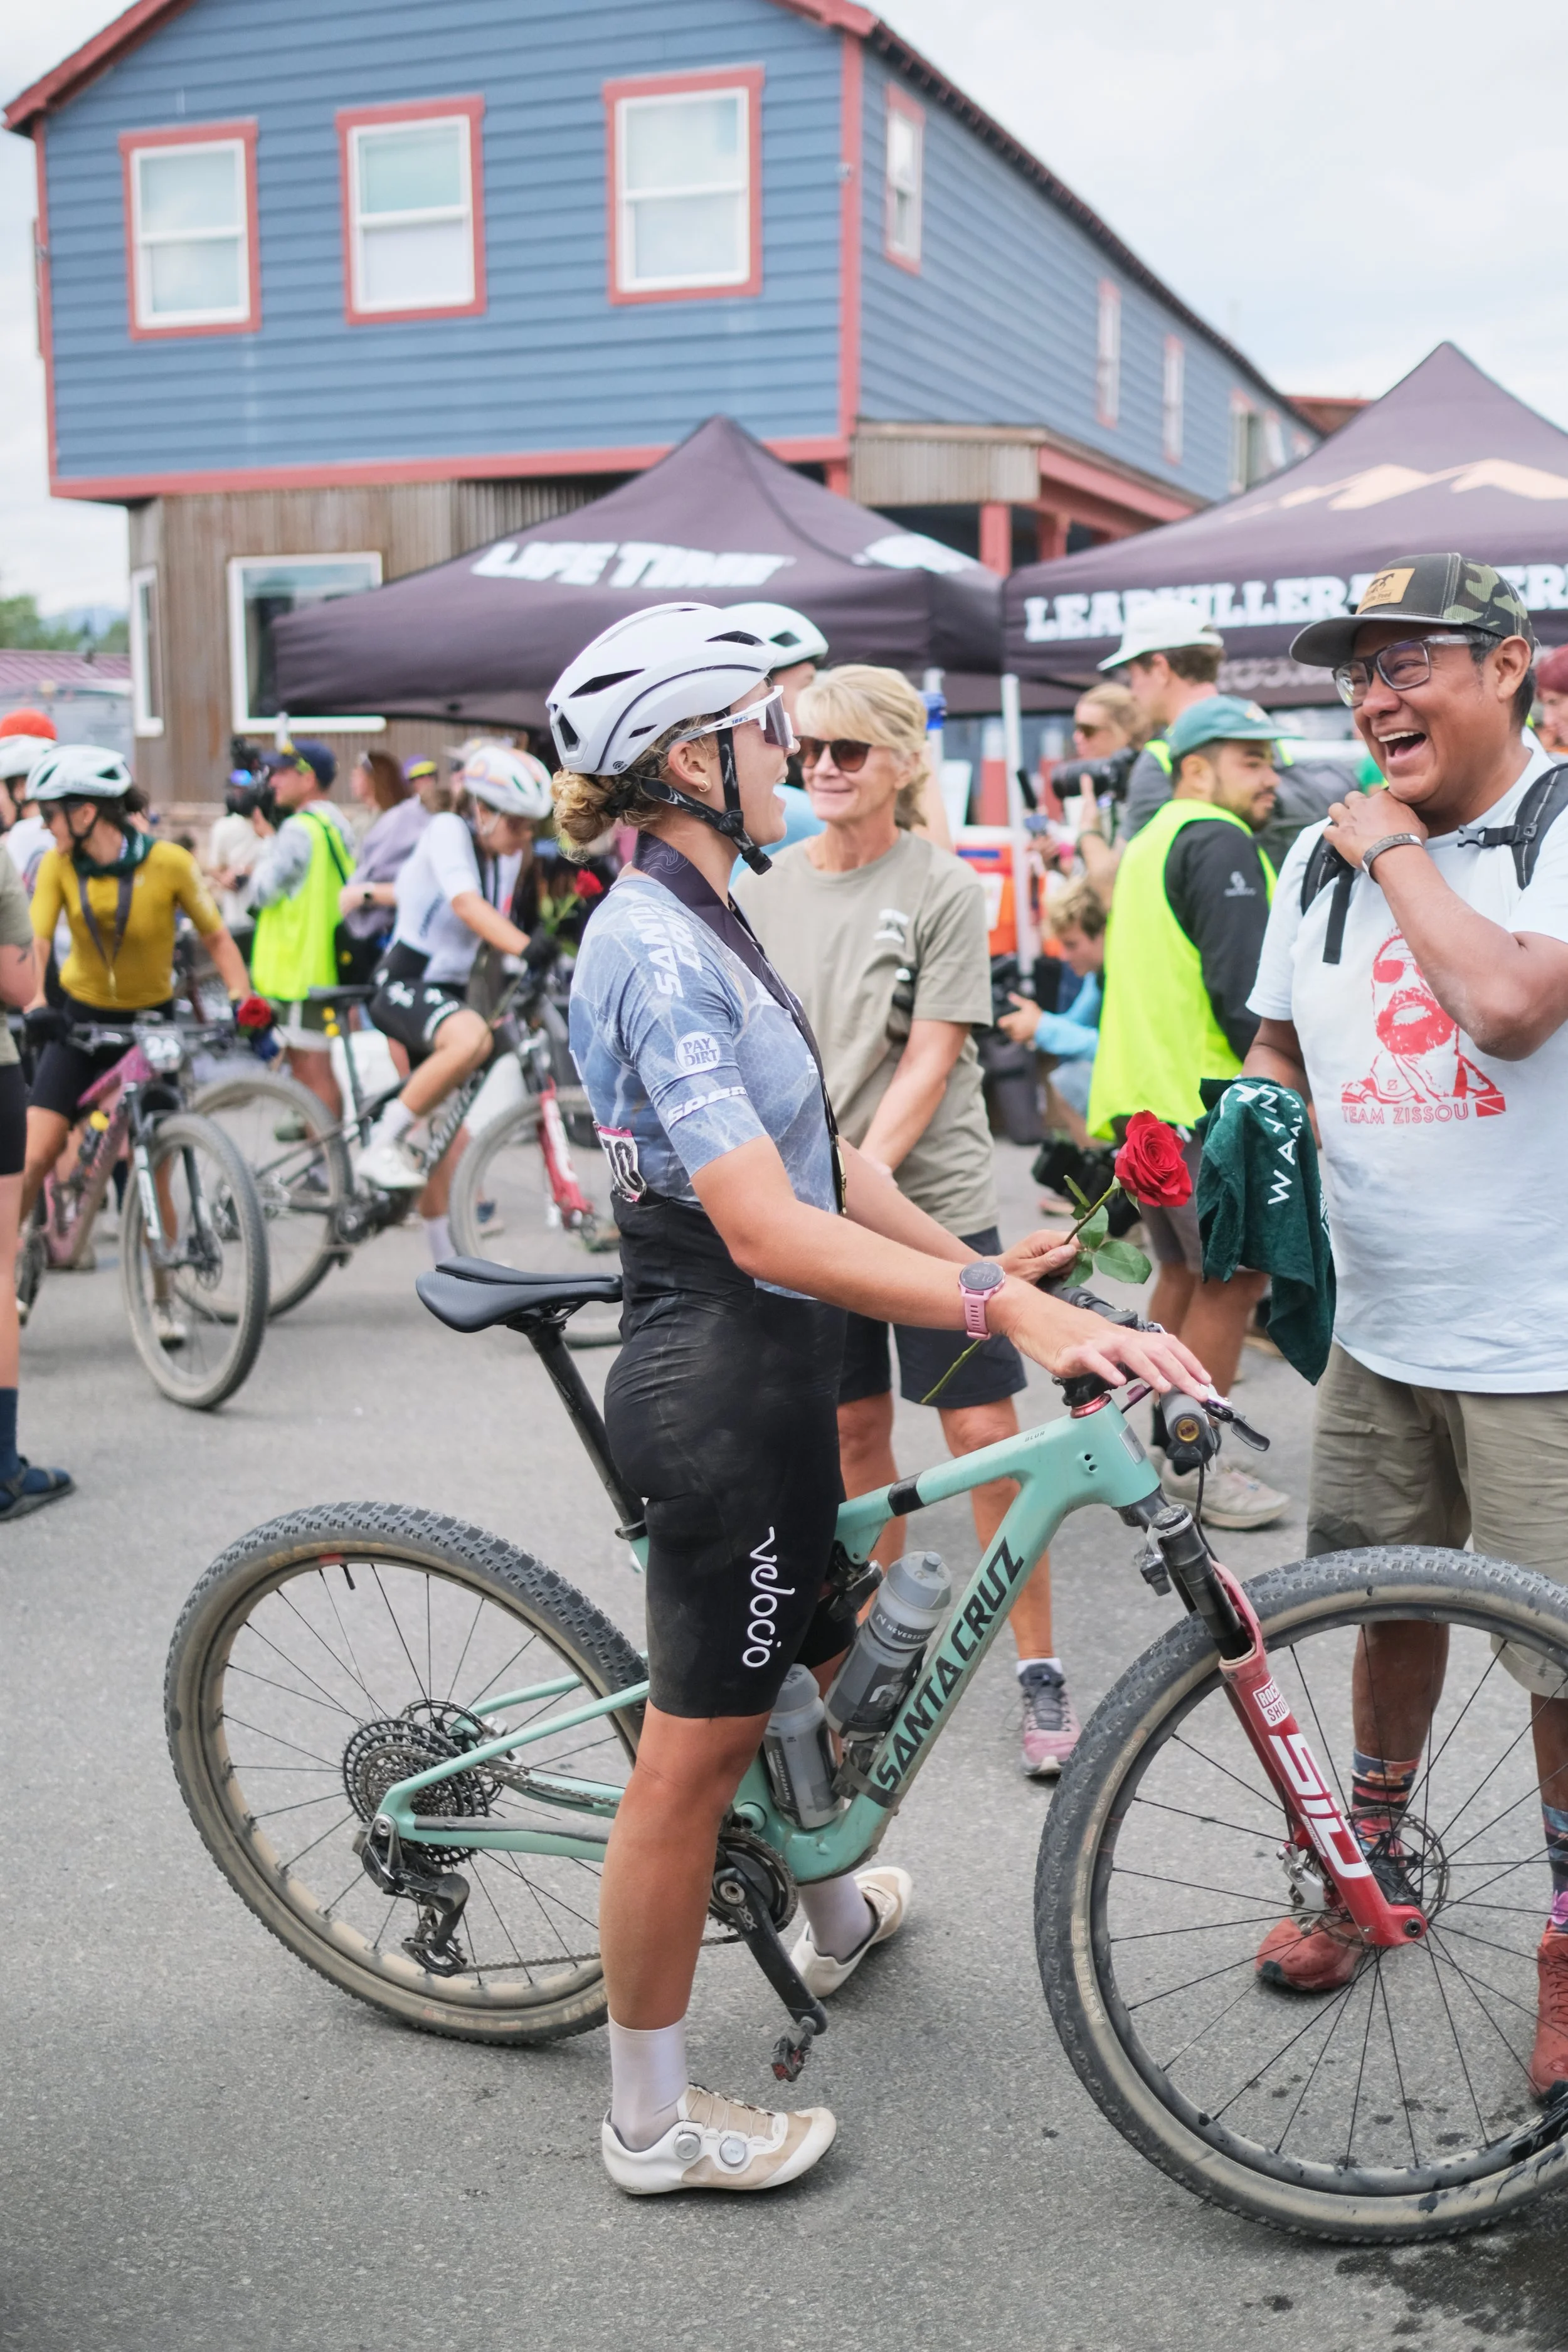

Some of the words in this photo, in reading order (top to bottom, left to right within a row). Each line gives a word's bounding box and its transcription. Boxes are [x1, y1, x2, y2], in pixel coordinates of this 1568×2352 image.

[682, 1037, 711, 1054] PAY
[684, 1049, 718, 1066] DIRT
[1342, 1105, 1385, 1124] TEAM
[1393, 1102, 1469, 1124] ZISSOU
[742, 1526, 796, 1668] velocio
[876, 1655, 963, 1793] SANTA
[951, 1536, 1025, 1662] CRUZ
[1071, 1914, 1087, 1946] ST
[1073, 1951, 1106, 2023] ASPEN
